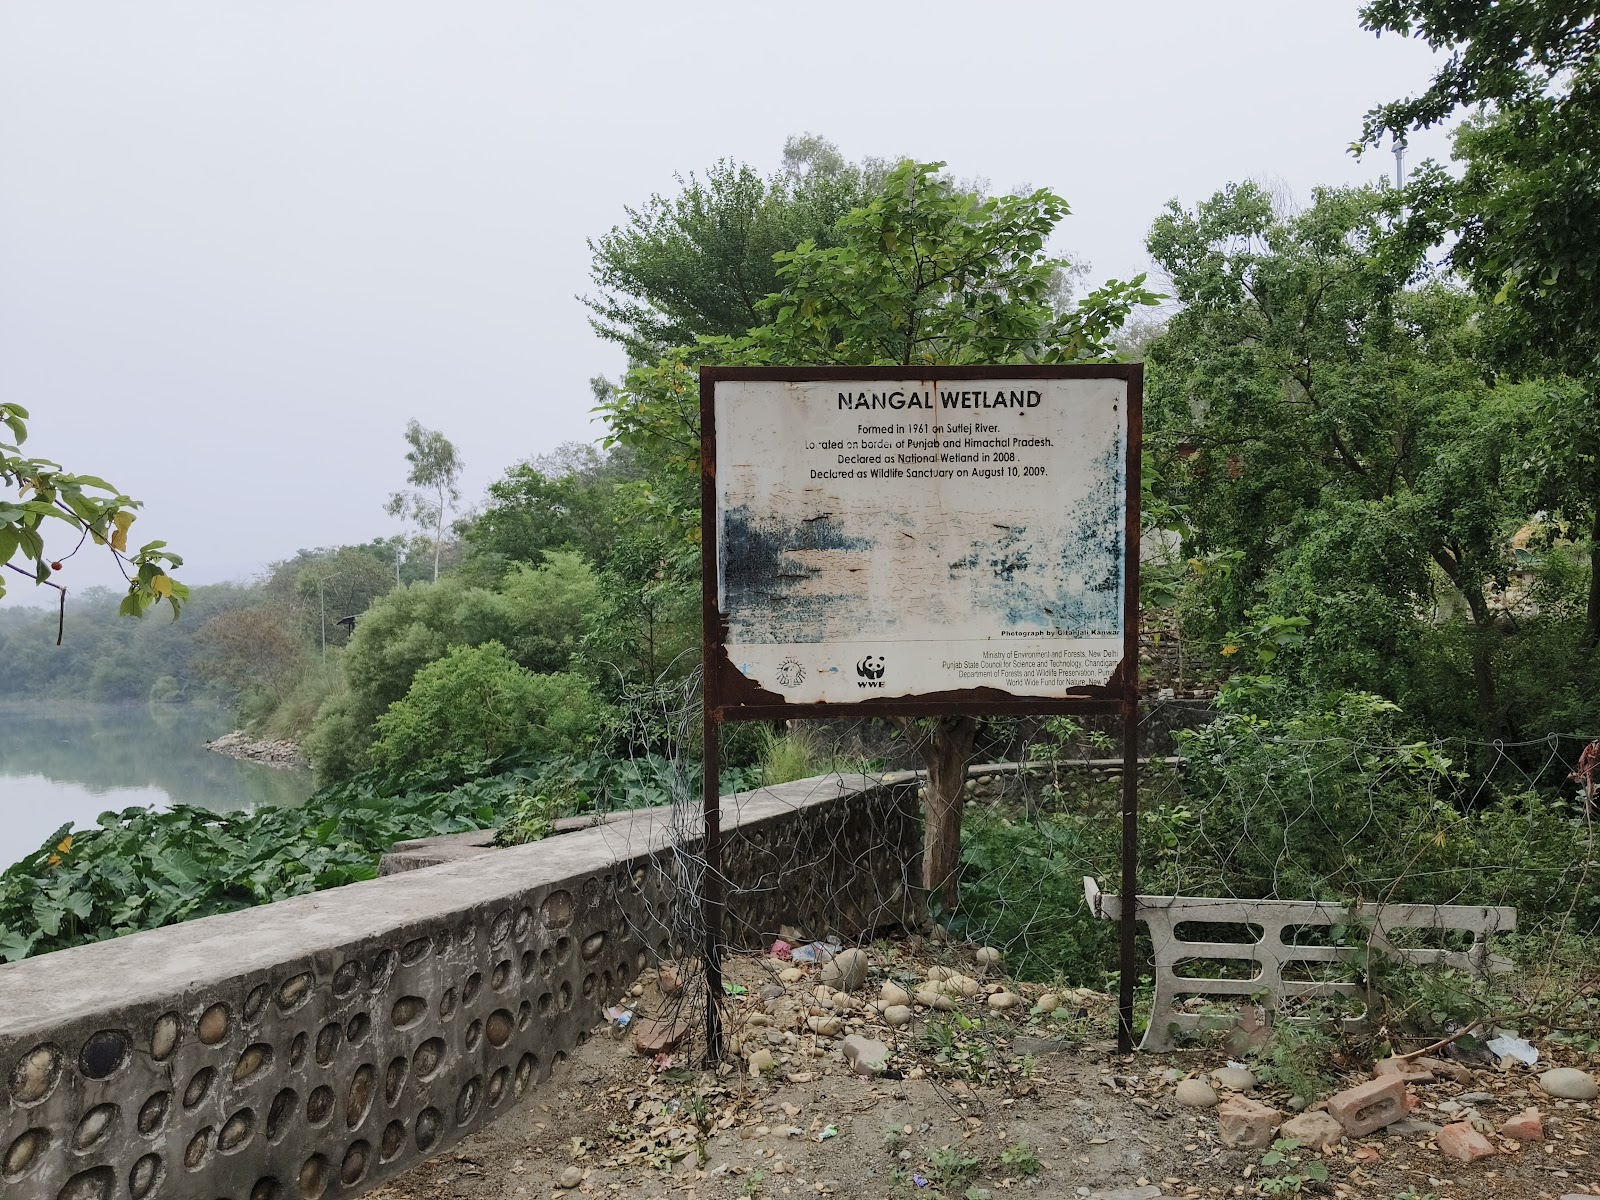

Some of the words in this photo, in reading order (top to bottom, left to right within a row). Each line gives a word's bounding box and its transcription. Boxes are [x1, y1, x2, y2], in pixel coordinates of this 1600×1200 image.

[838, 392, 933, 410] NANGAL
[941, 391, 1042, 409] WETLAND
[858, 425, 893, 434] Formed
[896, 424, 904, 433] in
[908, 424, 928, 433] 1961
[947, 424, 972, 435] Sutlej
[975, 423, 1000, 433] River.
[862, 439, 892, 448] border
[896, 439, 905, 448] of
[908, 439, 940, 451] Punjab
[943, 439, 961, 448] and
[964, 438, 1010, 448] Himachal
[1012, 438, 1054, 447] Pradesh.
[838, 454, 882, 464] Declared
[898, 454, 938, 464] National
[940, 453, 979, 463] Wetland
[982, 453, 990, 462] in
[811, 469, 854, 479] Declared
[870, 468, 904, 478] Wildlife
[906, 468, 954, 480] Sanctuary
[972, 467, 1004, 479] August
[1007, 467, 1020, 478] 10,
[1023, 467, 1048, 477] 2009.
[983, 651, 1005, 660] Ministry
[943, 661, 962, 670] Punjab
[959, 670, 992, 679] Department
[1098, 669, 1116, 677] Punja
